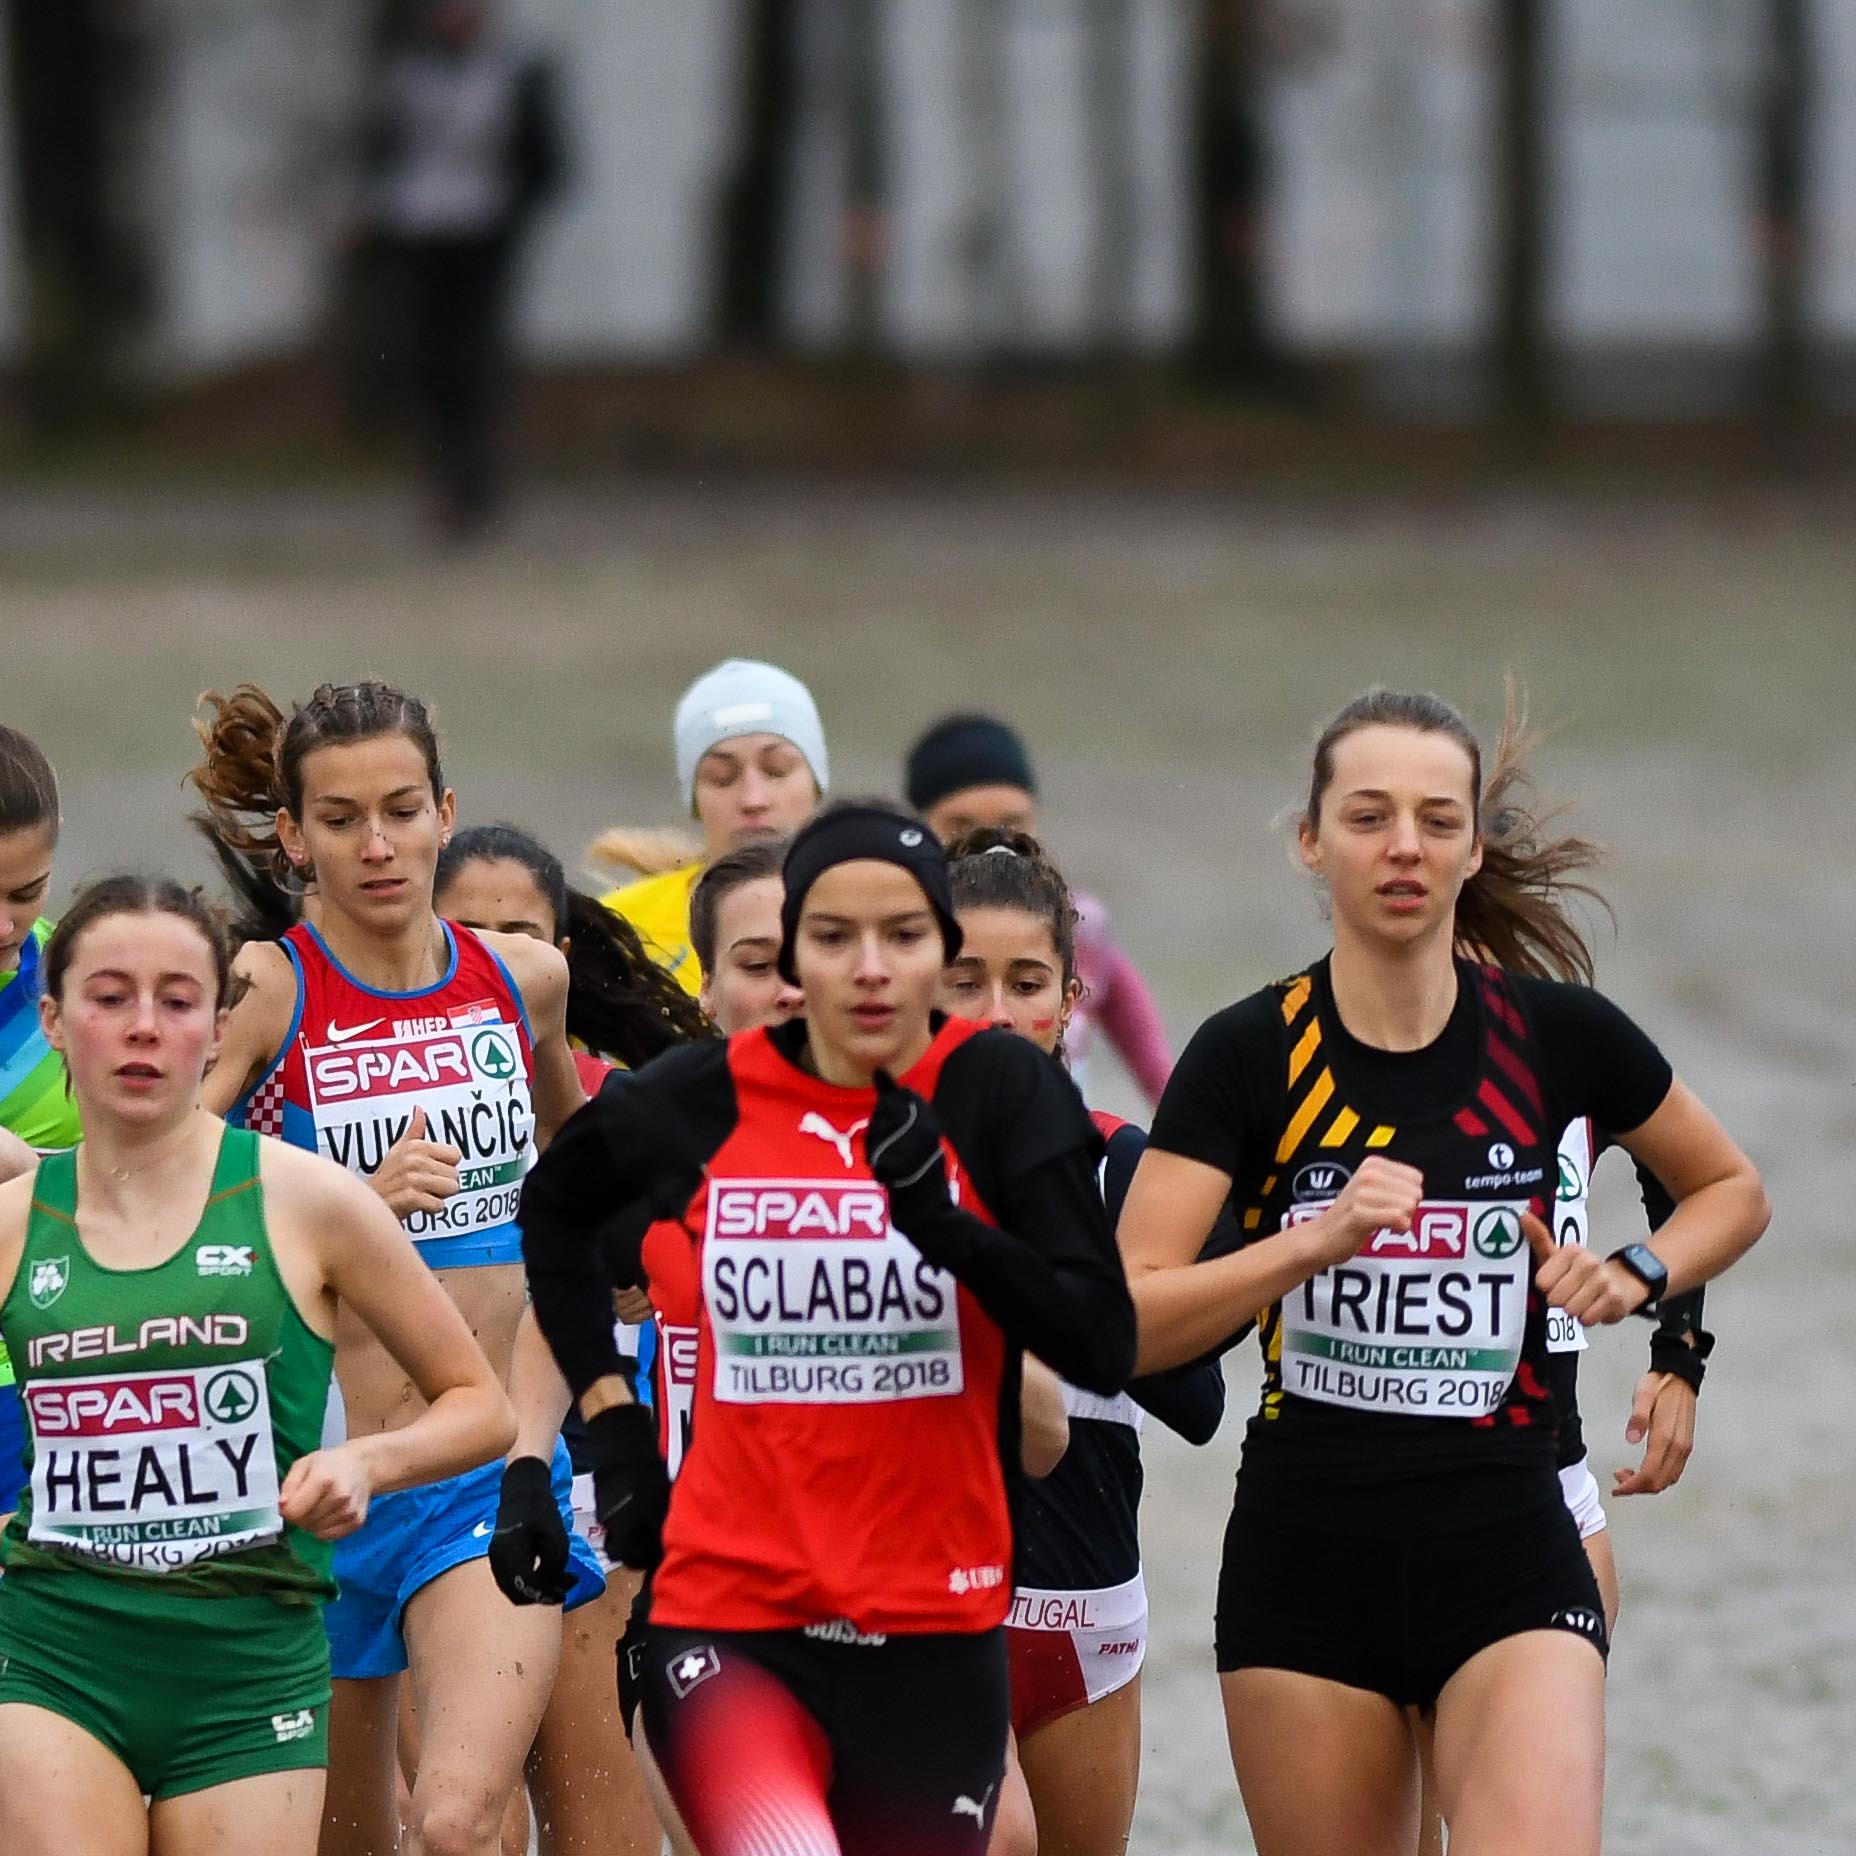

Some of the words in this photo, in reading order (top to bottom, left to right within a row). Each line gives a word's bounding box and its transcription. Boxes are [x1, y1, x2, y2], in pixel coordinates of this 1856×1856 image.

[316, 1042, 468, 1097] SPAR
[460, 1168, 494, 1190] EAN
[717, 1192, 886, 1235] SPAR
[196, 1245, 253, 1267] CX
[714, 1256, 945, 1323] SCLABAS
[1302, 1268, 1515, 1338] TRIEST
[27, 1313, 249, 1369] IRELAND
[1546, 1317, 1576, 1343] 018
[730, 1363, 864, 1394] TILBURG
[873, 1358, 950, 1393] 2018
[1340, 1343, 1387, 1367] RUN
[1395, 1347, 1468, 1370] CLEAN
[1294, 1359, 1428, 1407] TILBURG
[1437, 1378, 1506, 1407] 2018
[33, 1383, 195, 1431] SPAR
[45, 1431, 260, 1514] HEALY
[145, 1517, 221, 1541] CLEAN
[1011, 1595, 1095, 1629] TUGAL
